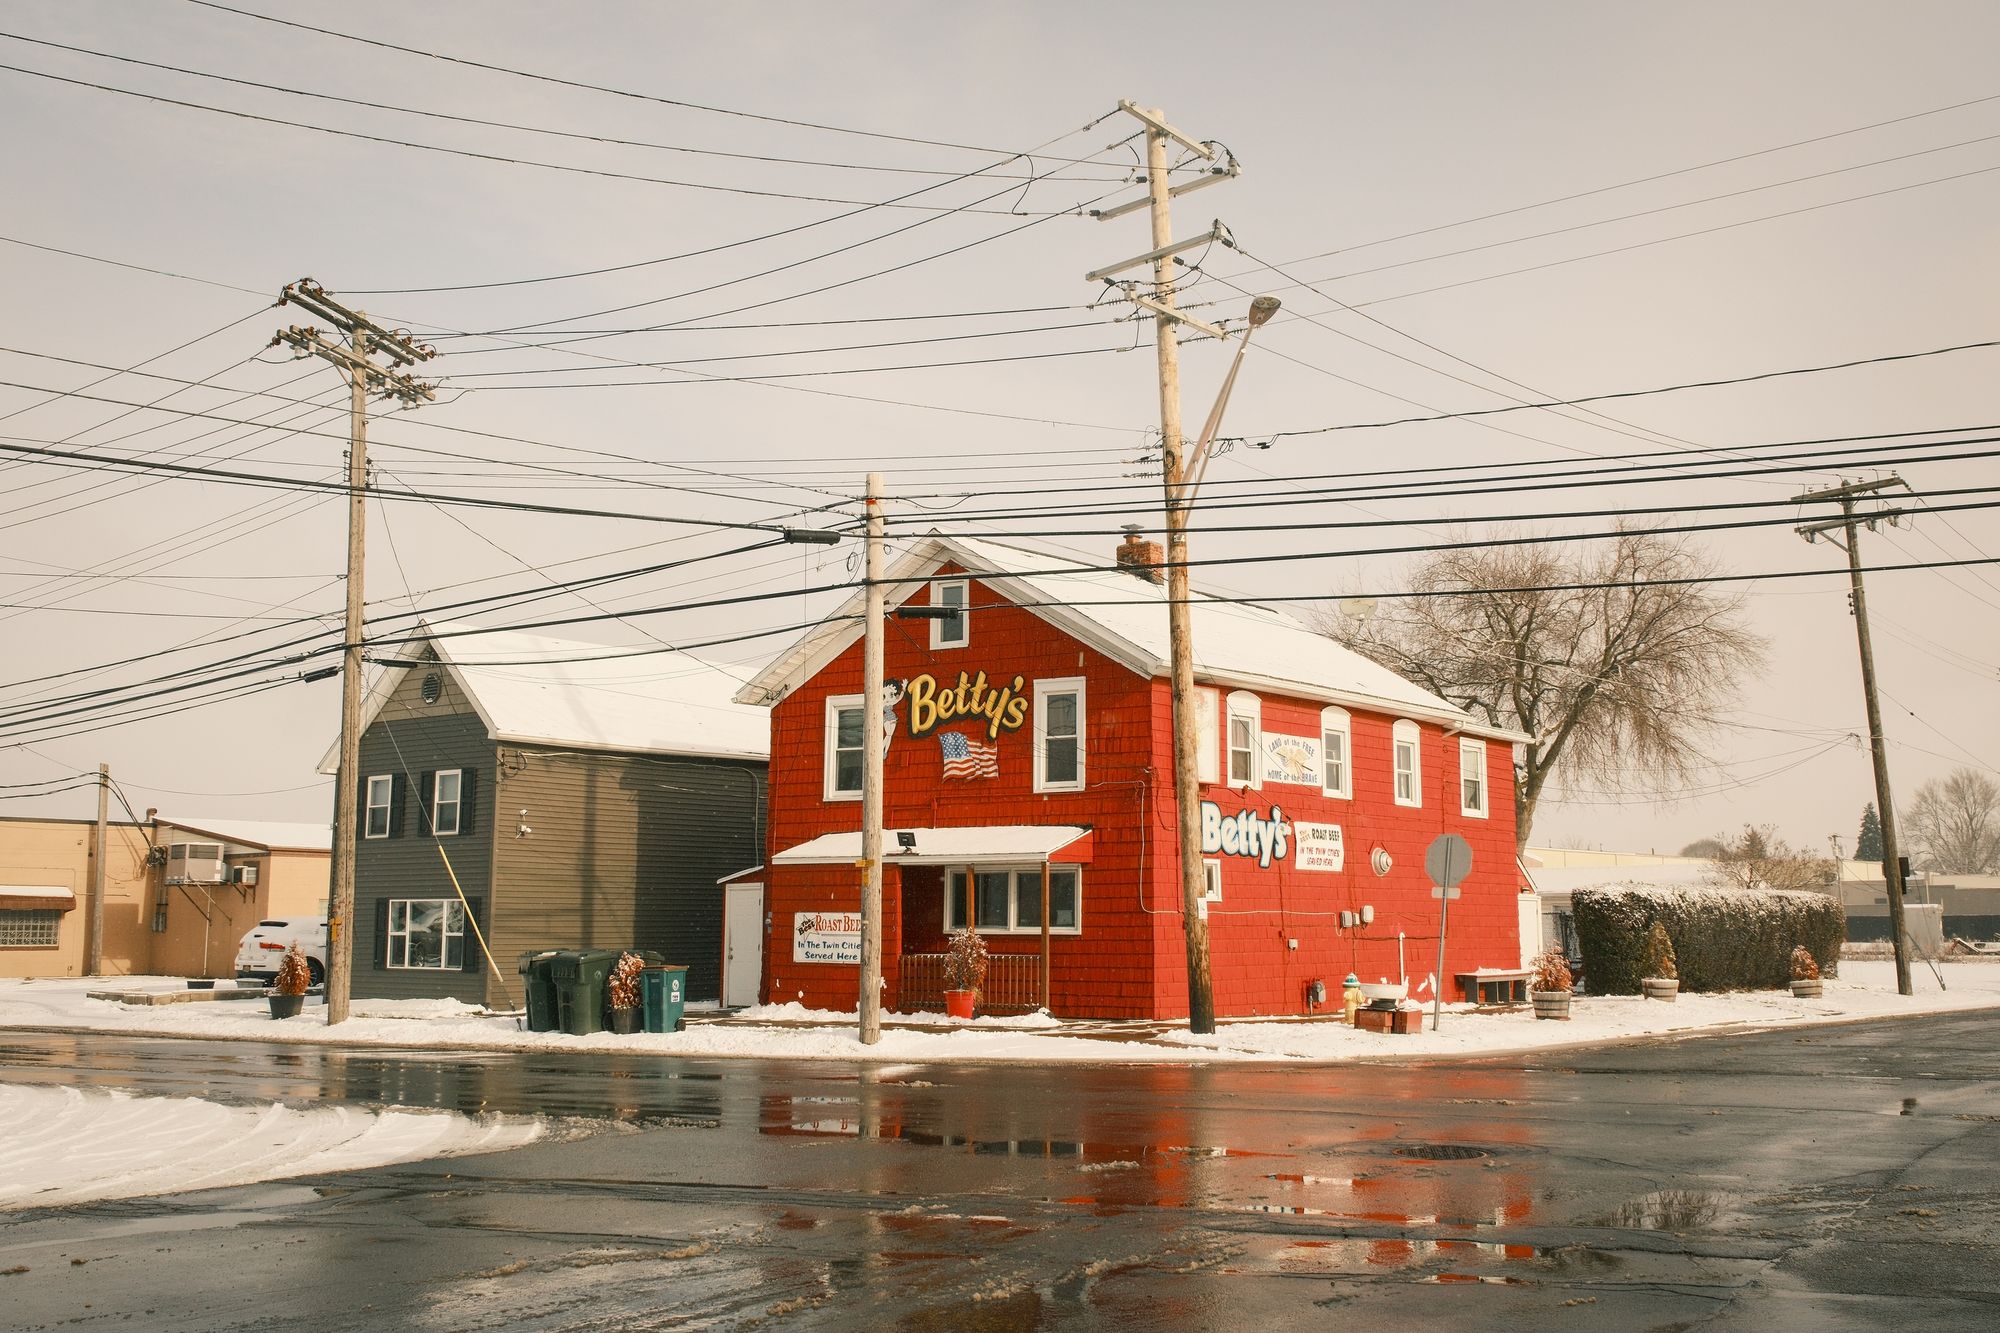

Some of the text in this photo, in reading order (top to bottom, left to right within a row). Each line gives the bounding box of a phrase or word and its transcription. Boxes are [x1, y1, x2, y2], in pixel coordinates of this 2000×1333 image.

[907, 669, 1029, 740] Betty's
[1200, 800, 1288, 868] Betty's
[1311, 828, 1328, 840] ROAST
[815, 914, 861, 932] ROAST BEE
[798, 941, 861, 950] In The Twin Citie
[805, 951, 833, 960] Served
